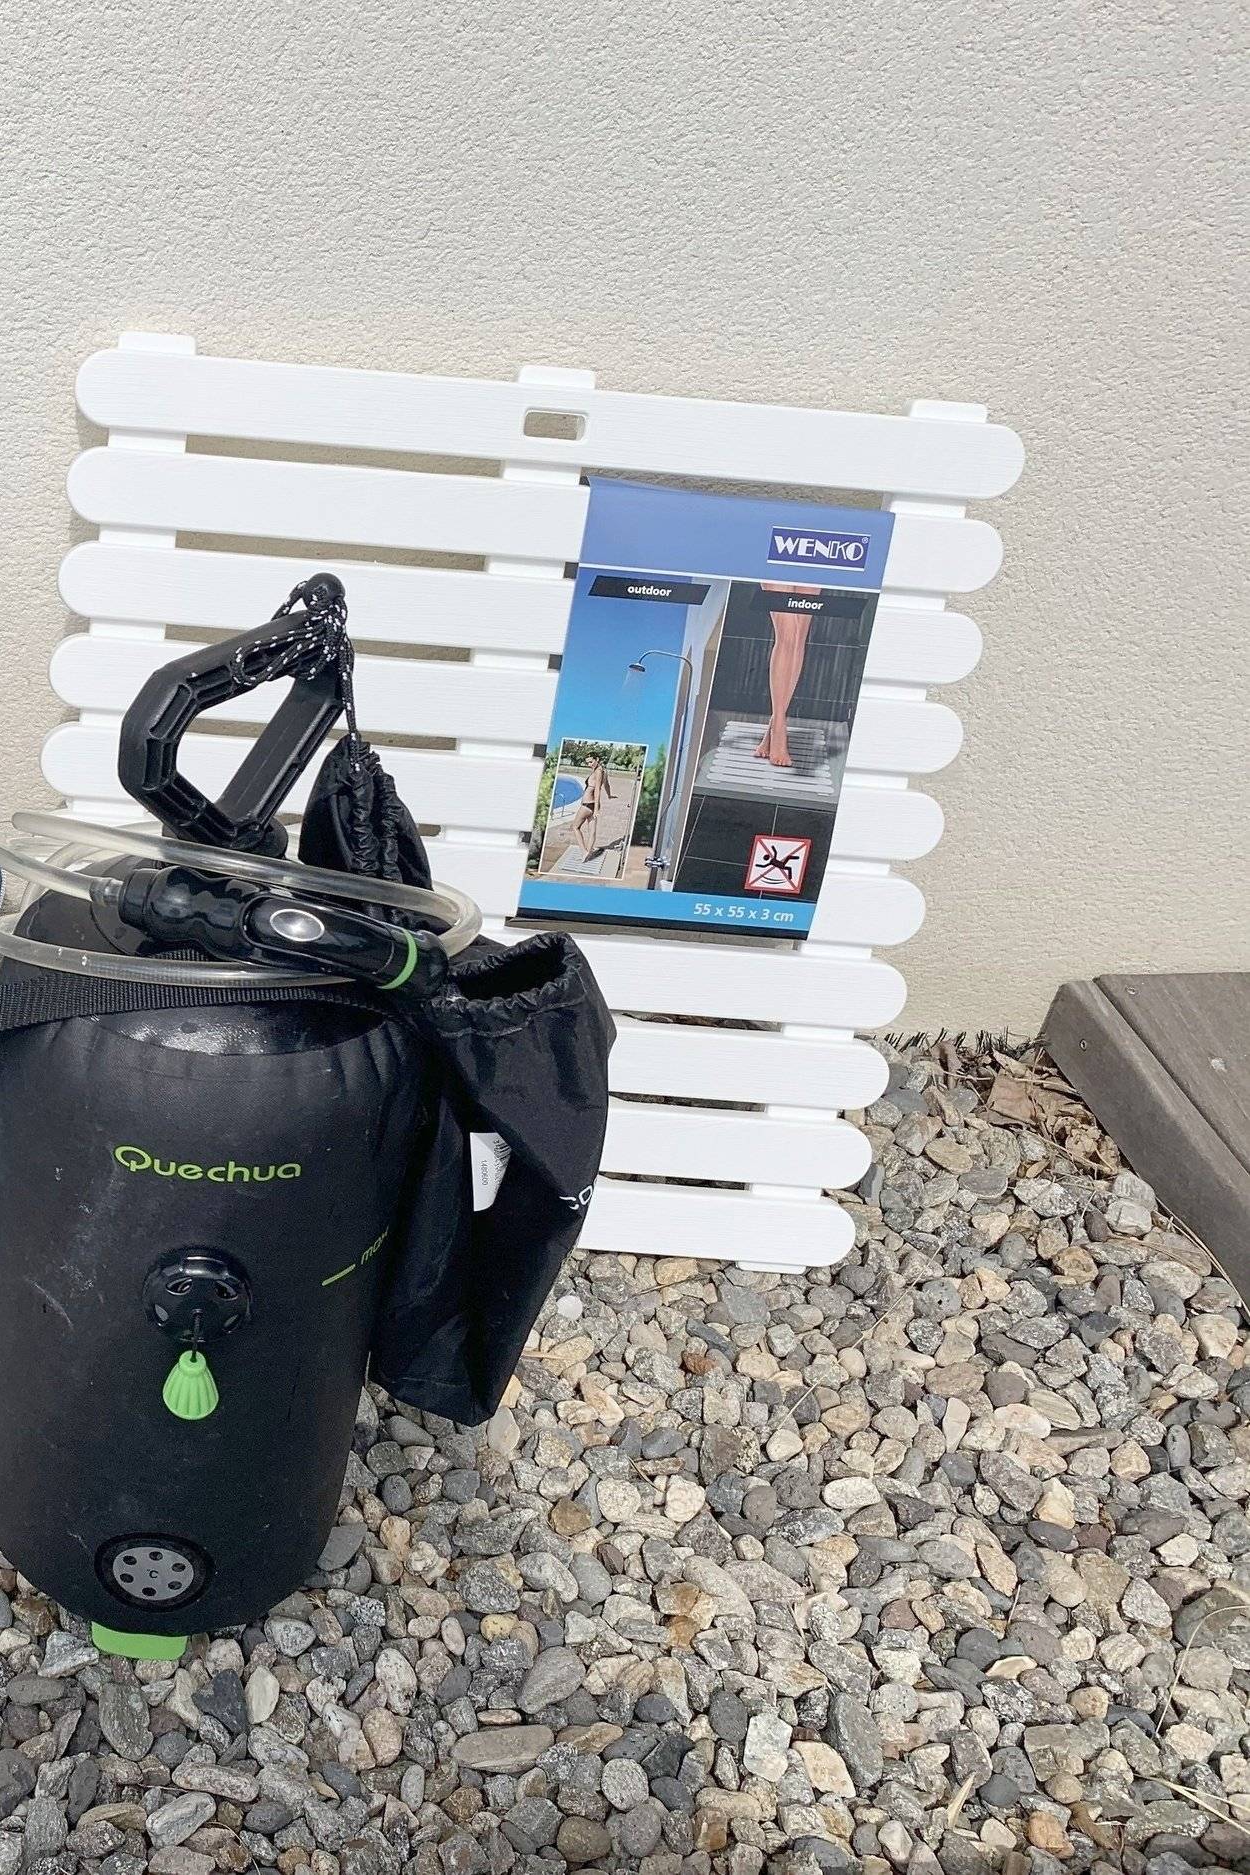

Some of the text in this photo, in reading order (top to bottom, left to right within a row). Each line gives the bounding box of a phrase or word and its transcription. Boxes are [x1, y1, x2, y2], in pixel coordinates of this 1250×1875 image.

[627, 584, 672, 597] outdoor
[787, 597, 823, 610] indoor
[694, 903, 794, 923] 55 x 55 x 3 cm
[114, 1145, 302, 1182] Quechua
